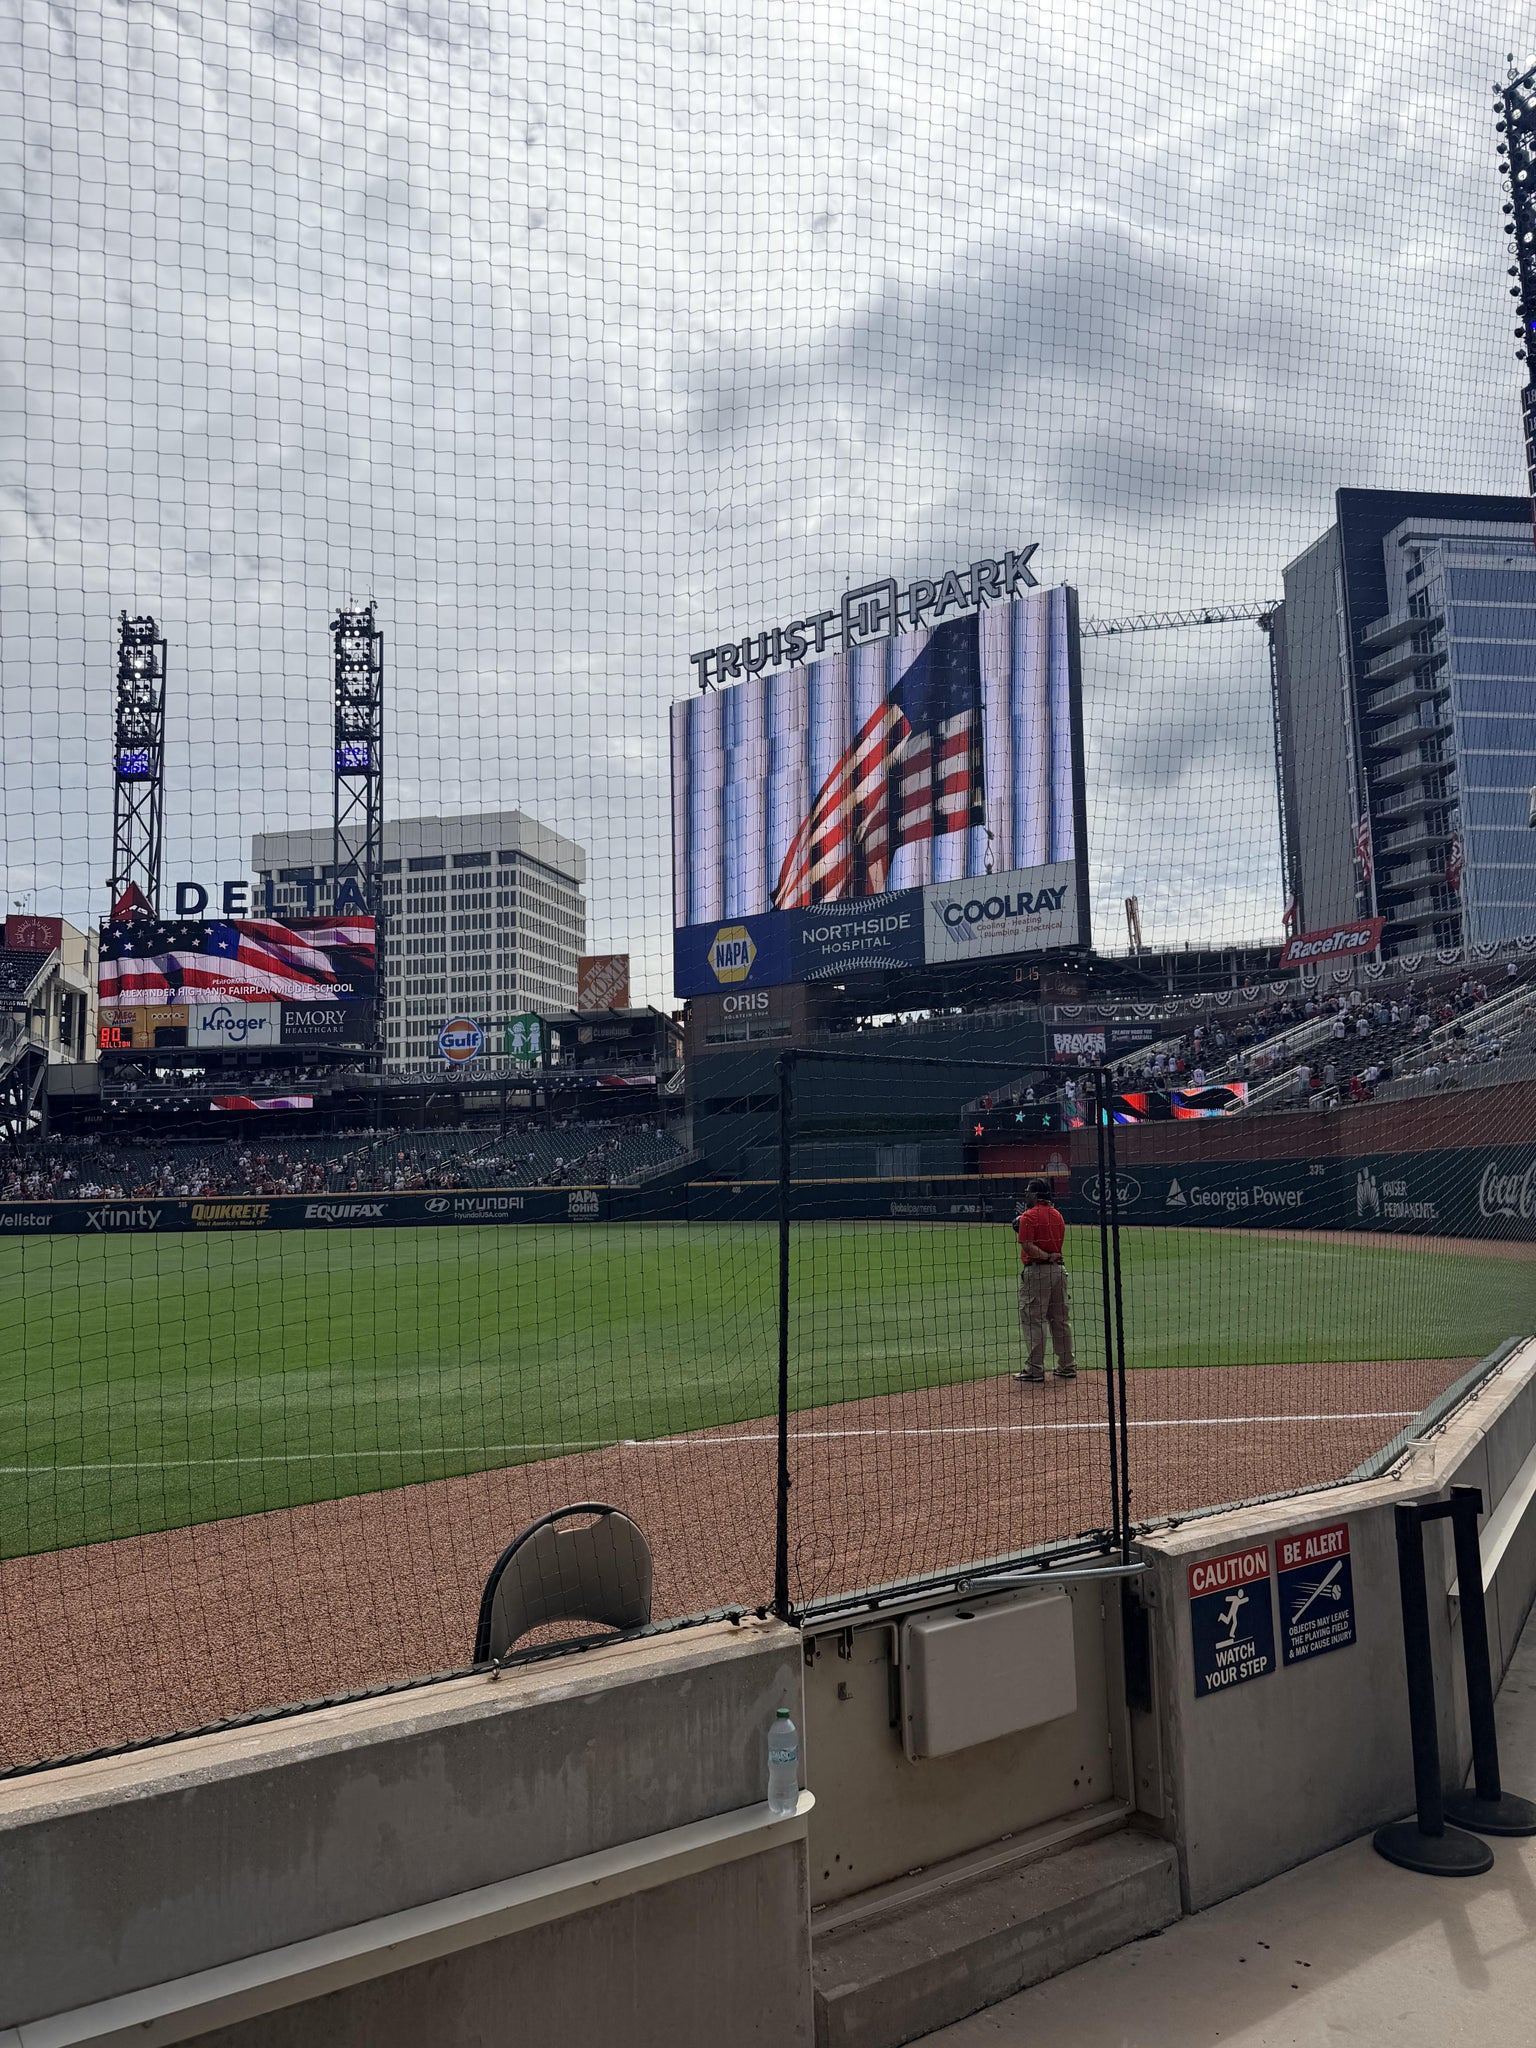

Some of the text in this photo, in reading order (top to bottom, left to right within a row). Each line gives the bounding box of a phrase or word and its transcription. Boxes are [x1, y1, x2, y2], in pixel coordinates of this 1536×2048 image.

[690, 542, 1040, 688] TRUIST PARK
[175, 878, 370, 916] DELTA
[943, 885, 1069, 927] COOLRAY
[802, 913, 911, 944] NORTHSIDE
[976, 916, 1042, 931] Cooling Heating
[716, 941, 749, 968] NAPA
[821, 936, 891, 955] HOSPITAL
[1287, 930, 1371, 960] RaceTrac
[120, 988, 175, 998] ALEXANDER
[178, 987, 201, 996] HIGH
[205, 987, 226, 995] AND
[229, 986, 273, 995] FAIRPLAY
[315, 983, 354, 993] SCHOOL
[579, 955, 629, 1009] HOME
[723, 992, 769, 1013] ORIS
[202, 1006, 266, 1042] Kroger
[285, 1010, 347, 1026] EMORY
[101, 1027, 121, 1041] 80
[285, 1026, 344, 1034] HEALTHCARE
[441, 1033, 479, 1047] Gulf
[1054, 1033, 1105, 1043] BRAVES
[1054, 1041, 1106, 1054] VISION
[1309, 1165, 1325, 1176] 375
[568, 1190, 599, 1203] PAPA
[1190, 1186, 1304, 1210] Georgia Power
[1382, 1181, 1408, 1196] KAISER
[191, 1204, 270, 1220] QUIKRETE
[304, 1203, 385, 1222] EQUIFAX
[454, 1197, 524, 1211] HYUNDAI
[567, 1203, 599, 1213] JOHNS
[85, 1204, 162, 1230] xfinity
[1283, 1530, 1344, 1565] BE ALERT
[1192, 1550, 1267, 1591] CAUTION
[1288, 1609, 1350, 1636] OBJECTS MAY LEAVE
[1291, 1621, 1349, 1646] THE PLAYING FIELD
[1215, 1642, 1256, 1668] WATCH
[1289, 1630, 1352, 1659] & MAY CAUSE INJURY
[1205, 1656, 1268, 1690] YOUR STEP
